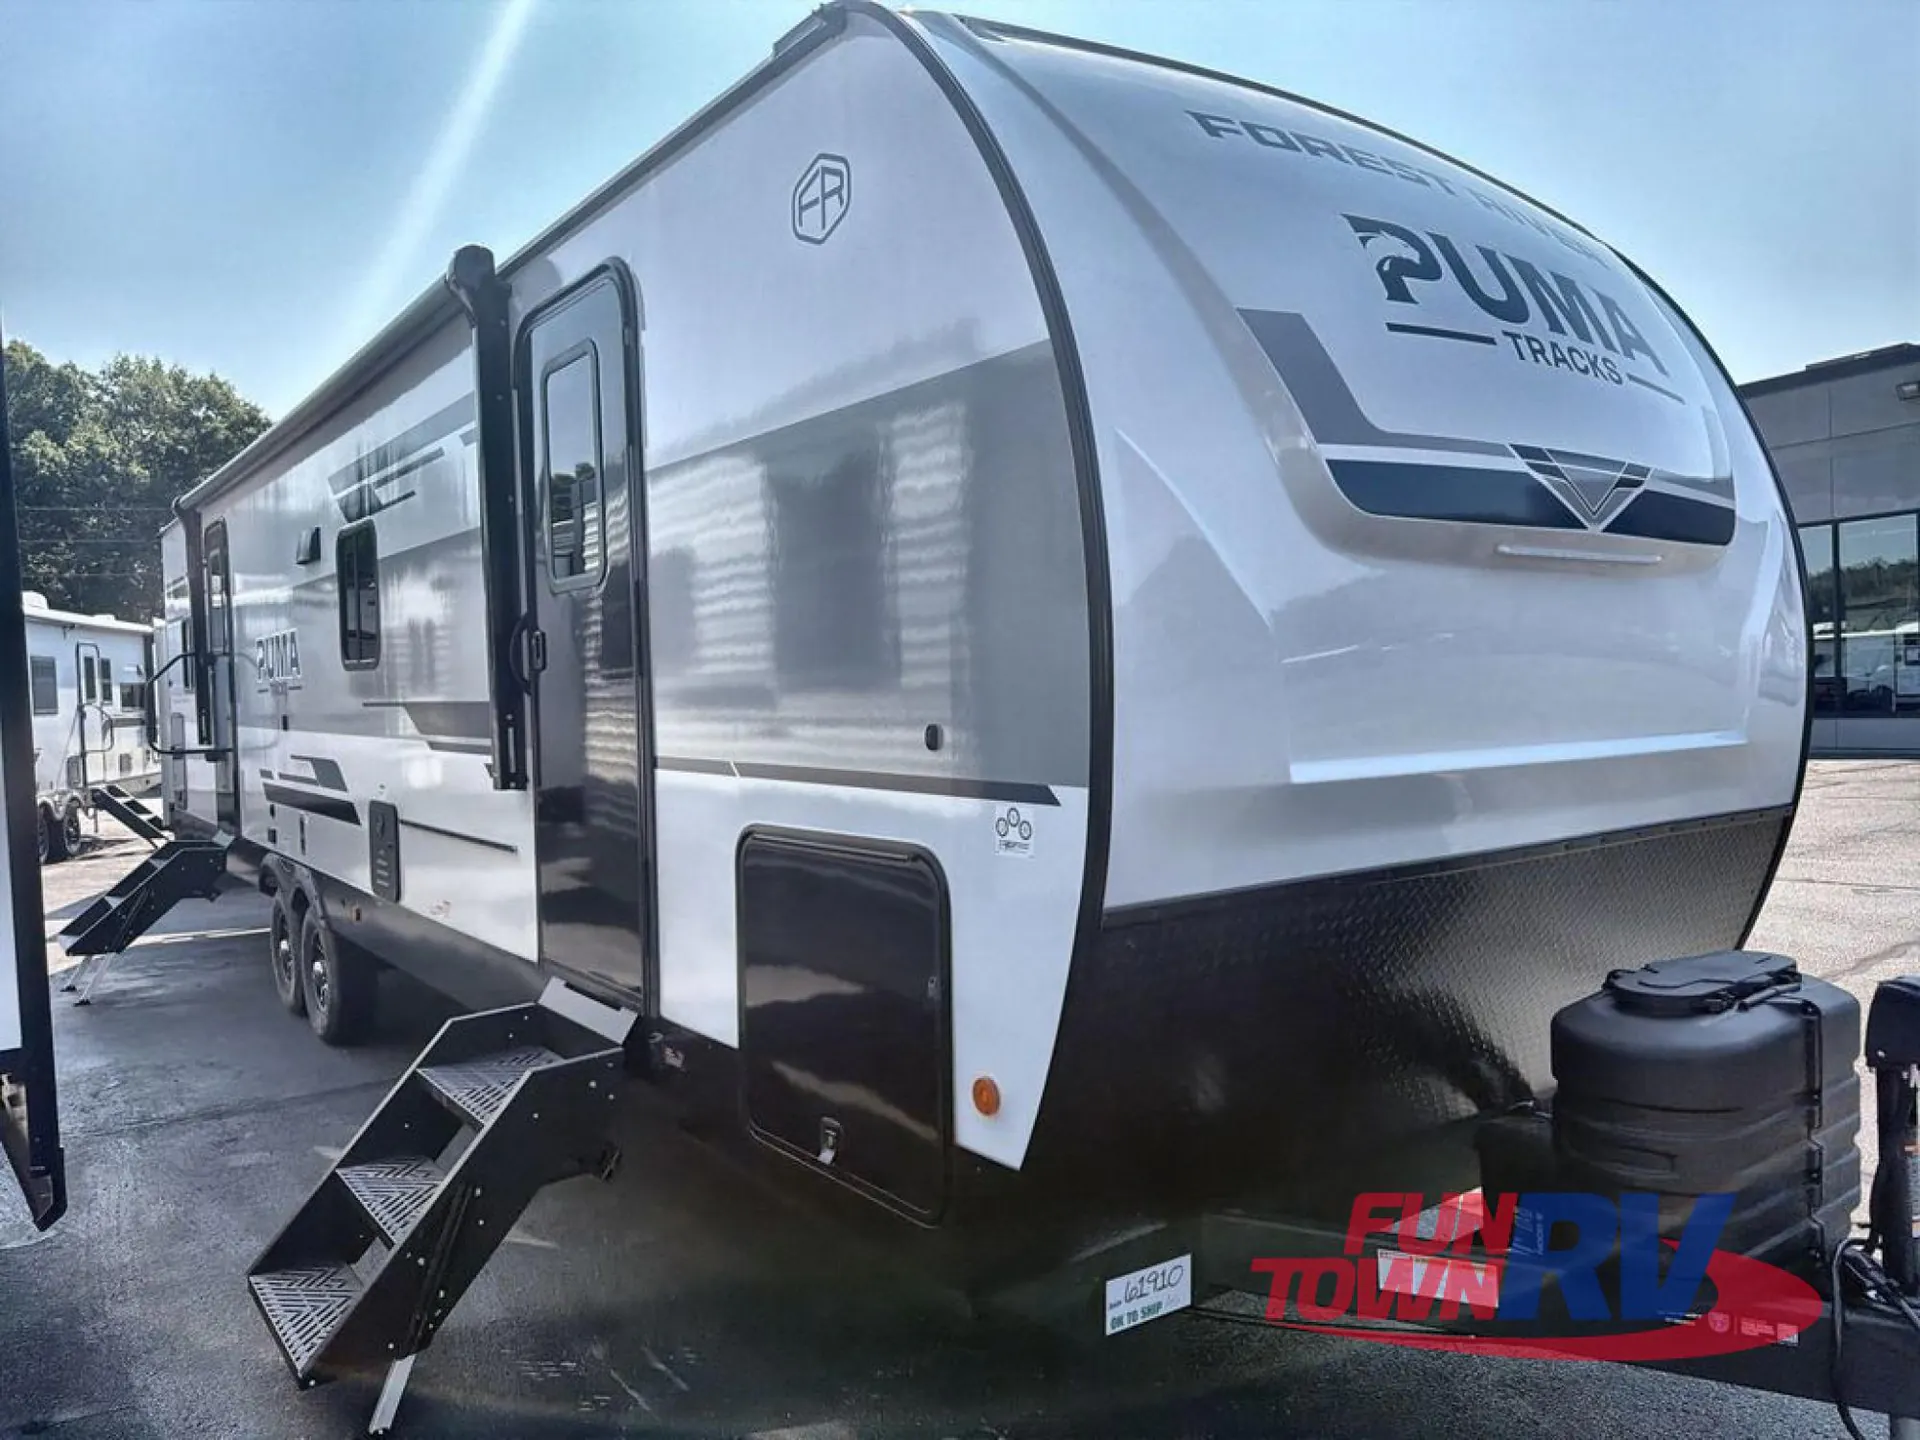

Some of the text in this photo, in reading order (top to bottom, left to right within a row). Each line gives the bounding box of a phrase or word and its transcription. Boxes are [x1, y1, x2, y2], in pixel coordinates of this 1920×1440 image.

[1184, 109, 1457, 196] FOREST
[1340, 213, 1669, 378] PUMA
[1501, 329, 1623, 386] TRACKS
[1124, 1265, 1184, 1303] 61910
